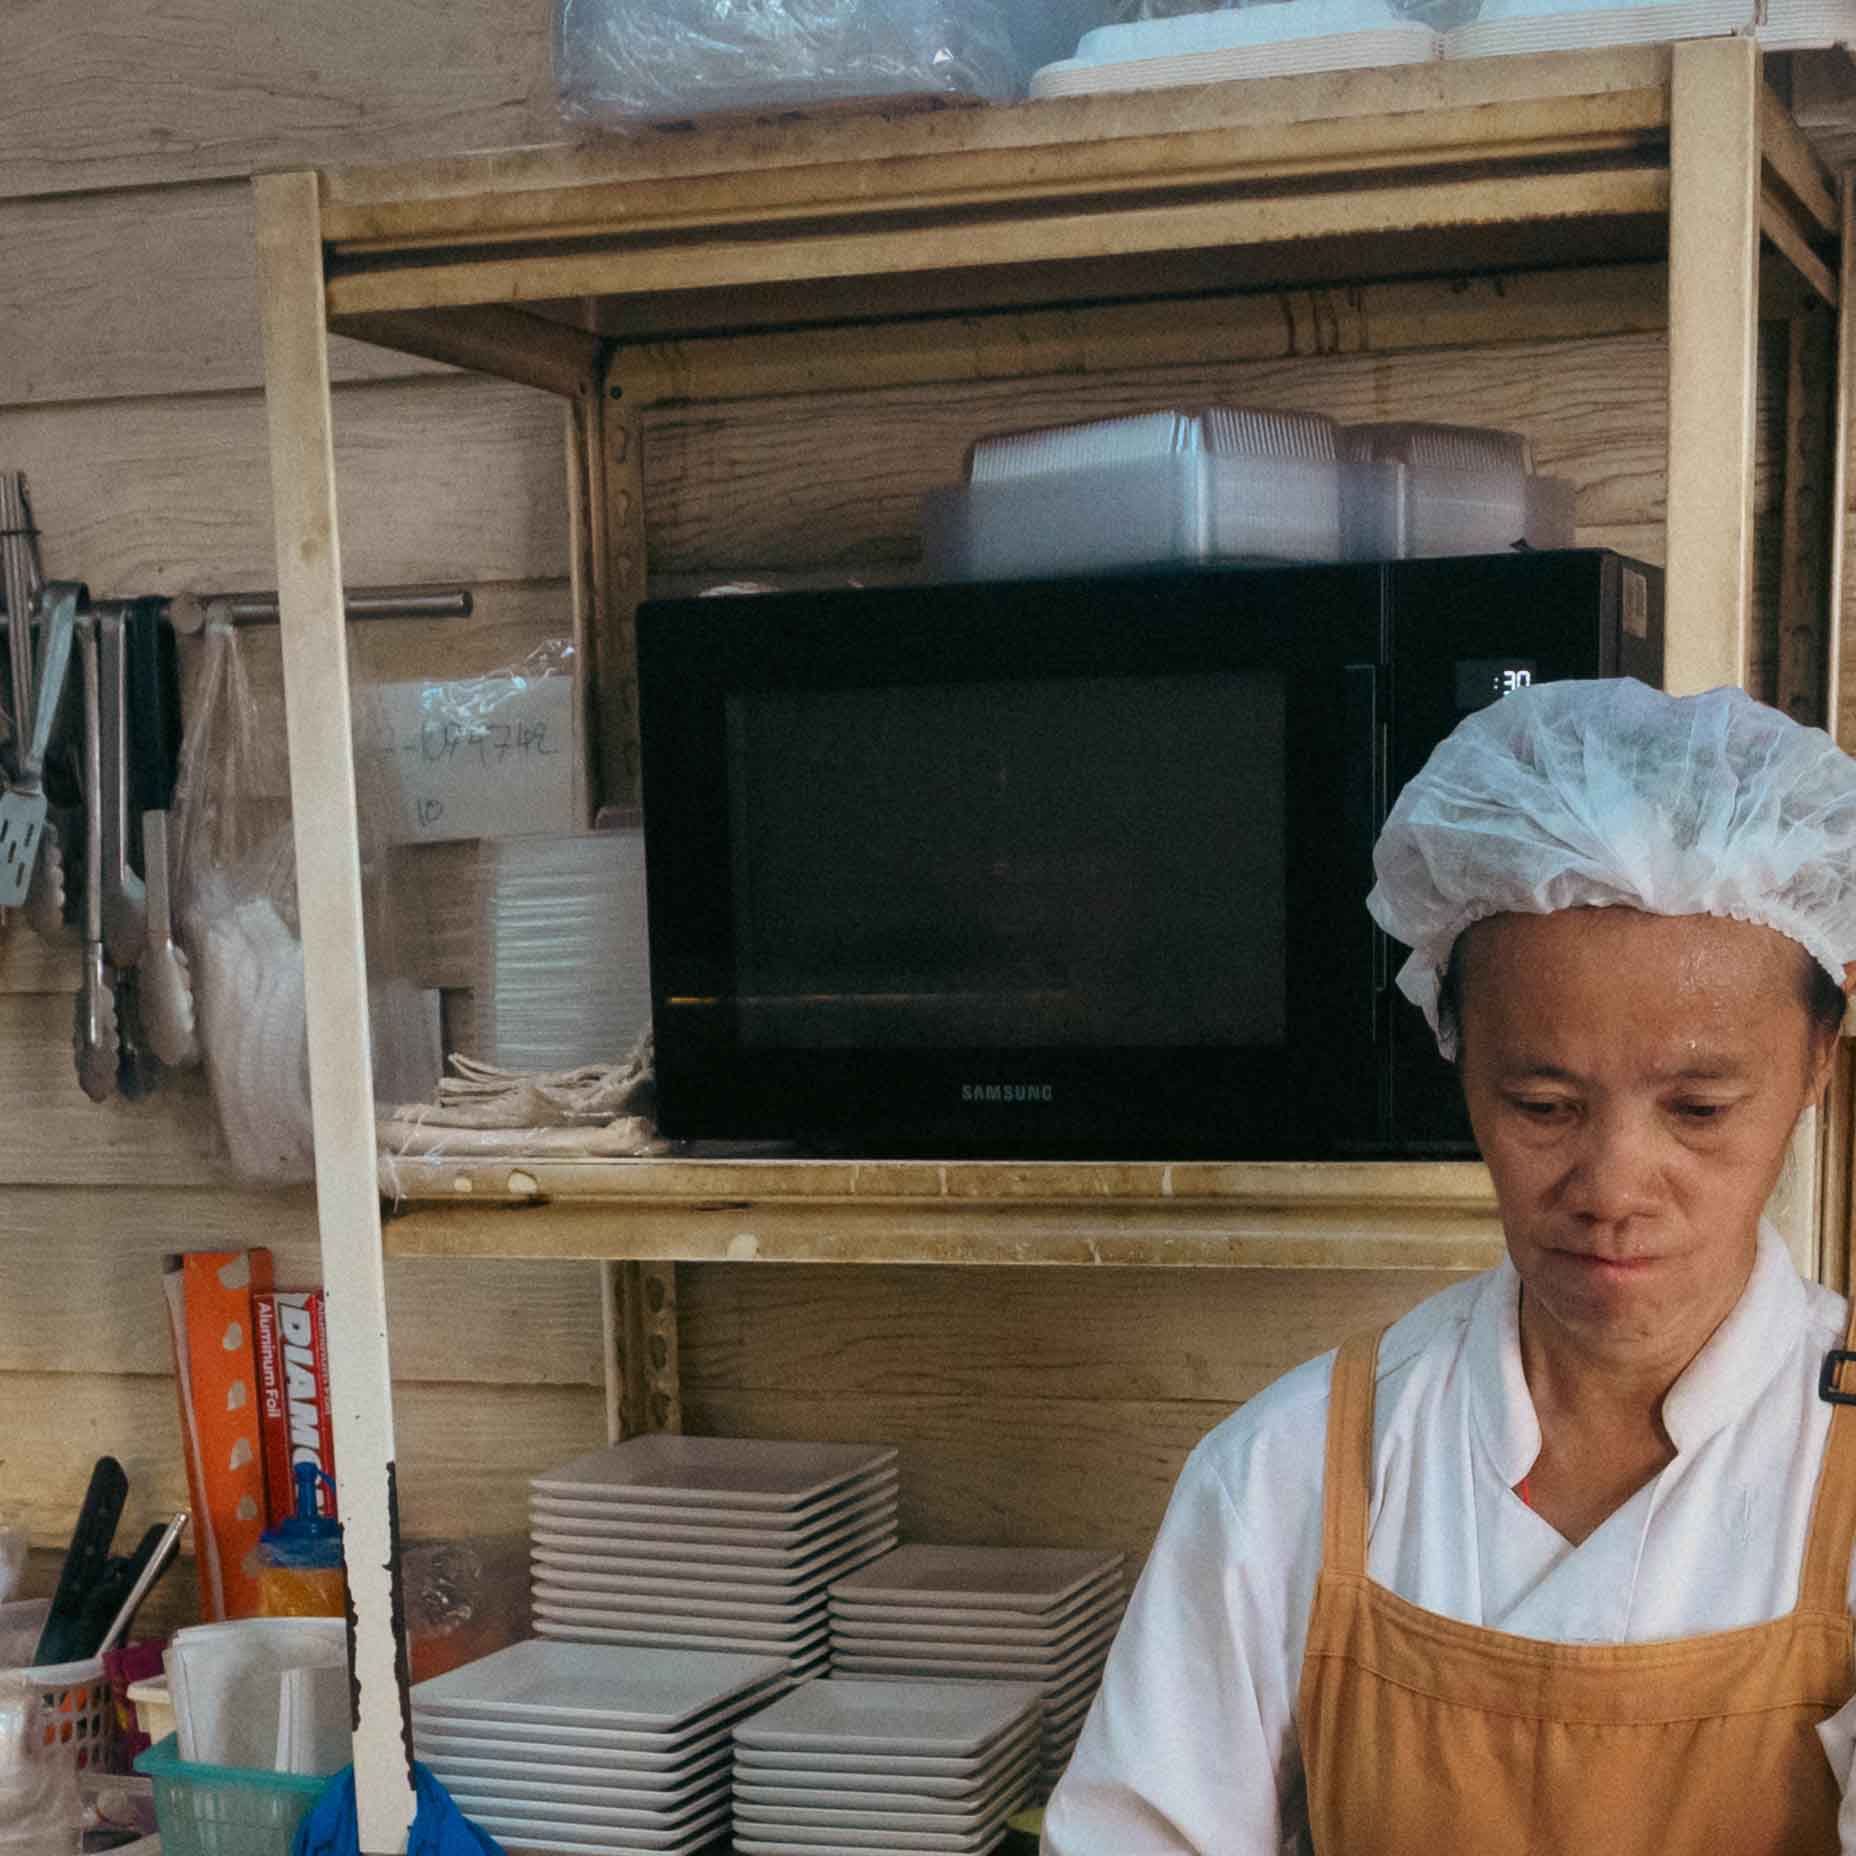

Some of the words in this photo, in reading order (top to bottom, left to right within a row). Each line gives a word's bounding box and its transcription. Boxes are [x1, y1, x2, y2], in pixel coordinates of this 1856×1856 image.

[961, 1084, 1054, 1102] SAMSUNG
[257, 1302, 277, 1386] Aluminum
[265, 1389, 282, 1418] Foil
